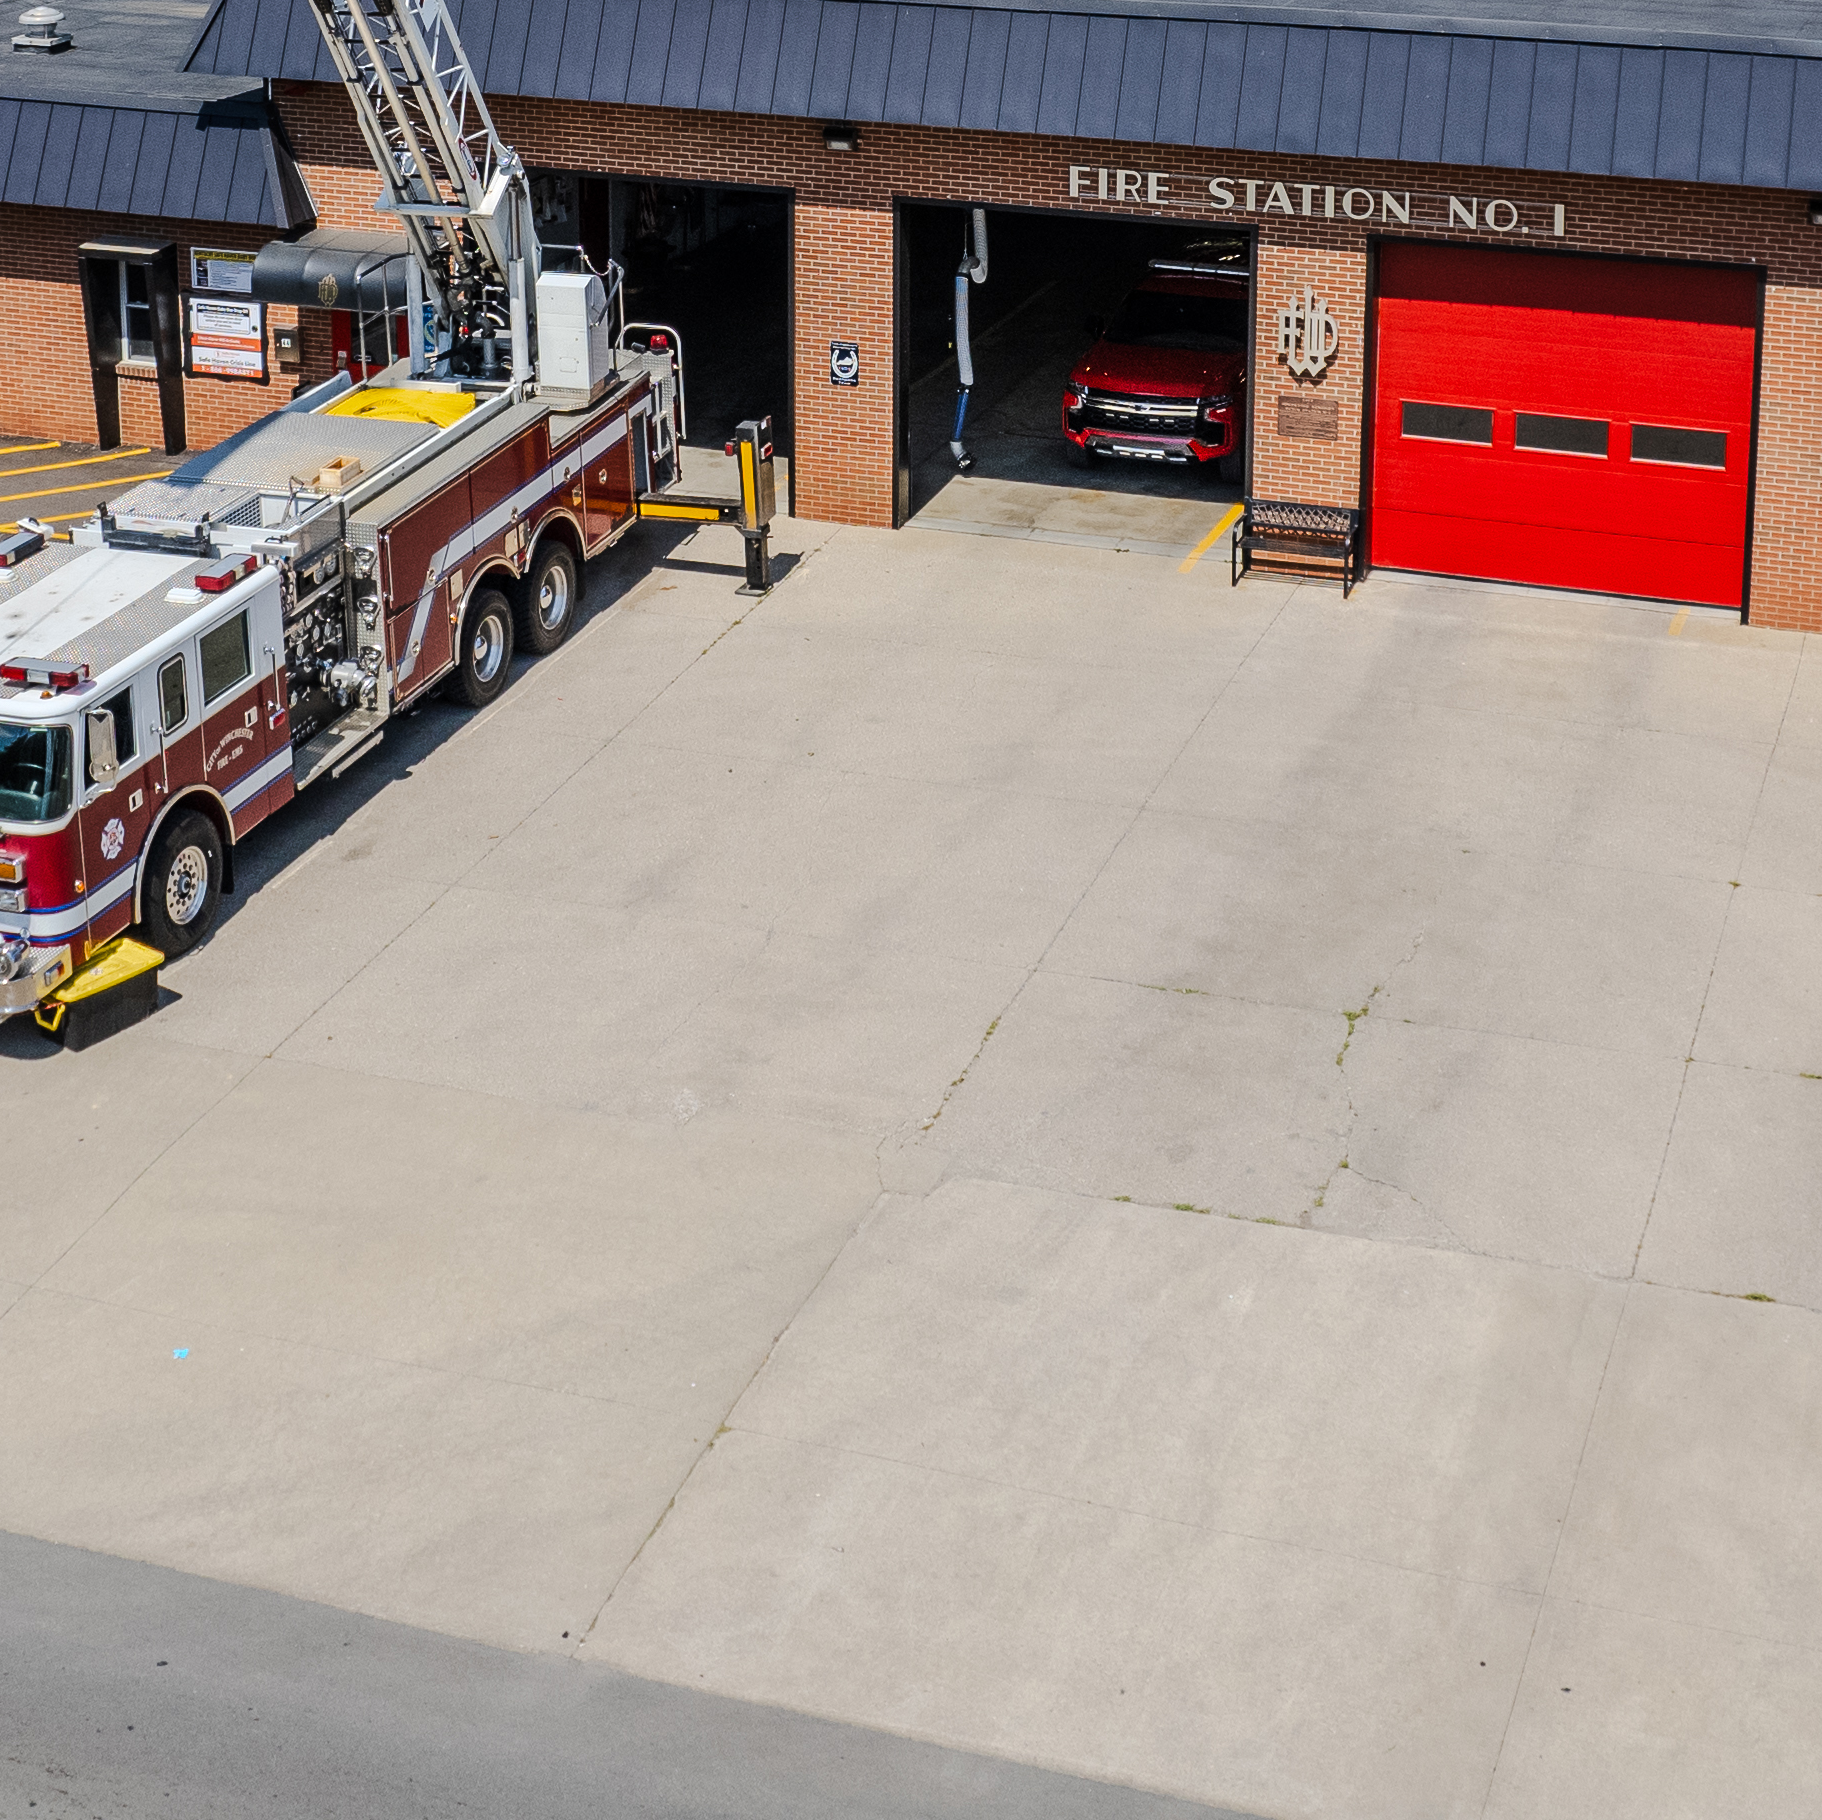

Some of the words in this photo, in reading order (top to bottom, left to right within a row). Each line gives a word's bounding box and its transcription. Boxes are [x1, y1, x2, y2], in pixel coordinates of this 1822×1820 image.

[1069, 165, 1170, 205] FIRE
[1208, 176, 1411, 225] STATION
[1448, 195, 1529, 235] NO.
[1553, 203, 1565, 237] 1
